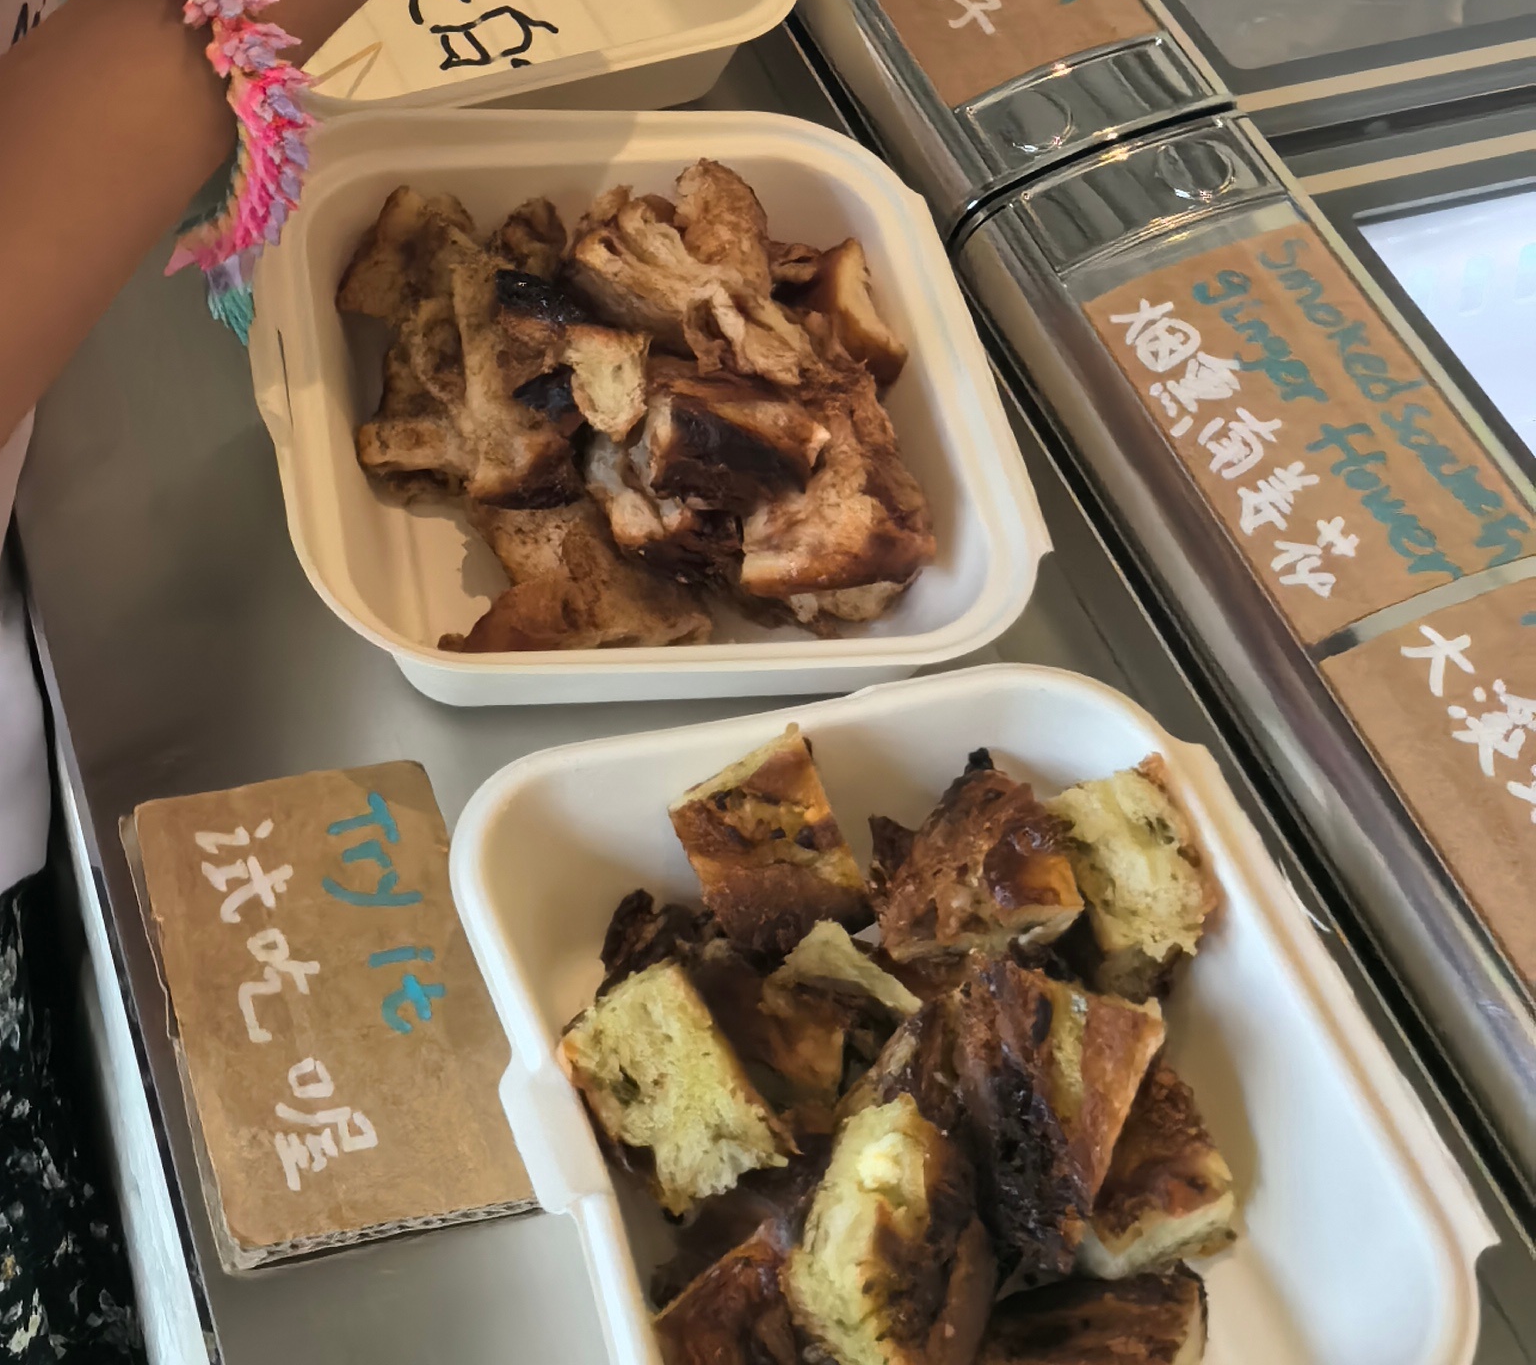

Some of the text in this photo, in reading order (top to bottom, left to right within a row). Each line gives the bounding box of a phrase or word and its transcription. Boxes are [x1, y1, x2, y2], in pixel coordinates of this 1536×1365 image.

[1400, 624, 1536, 823] 大溪
[321, 791, 447, 1035] Try it
